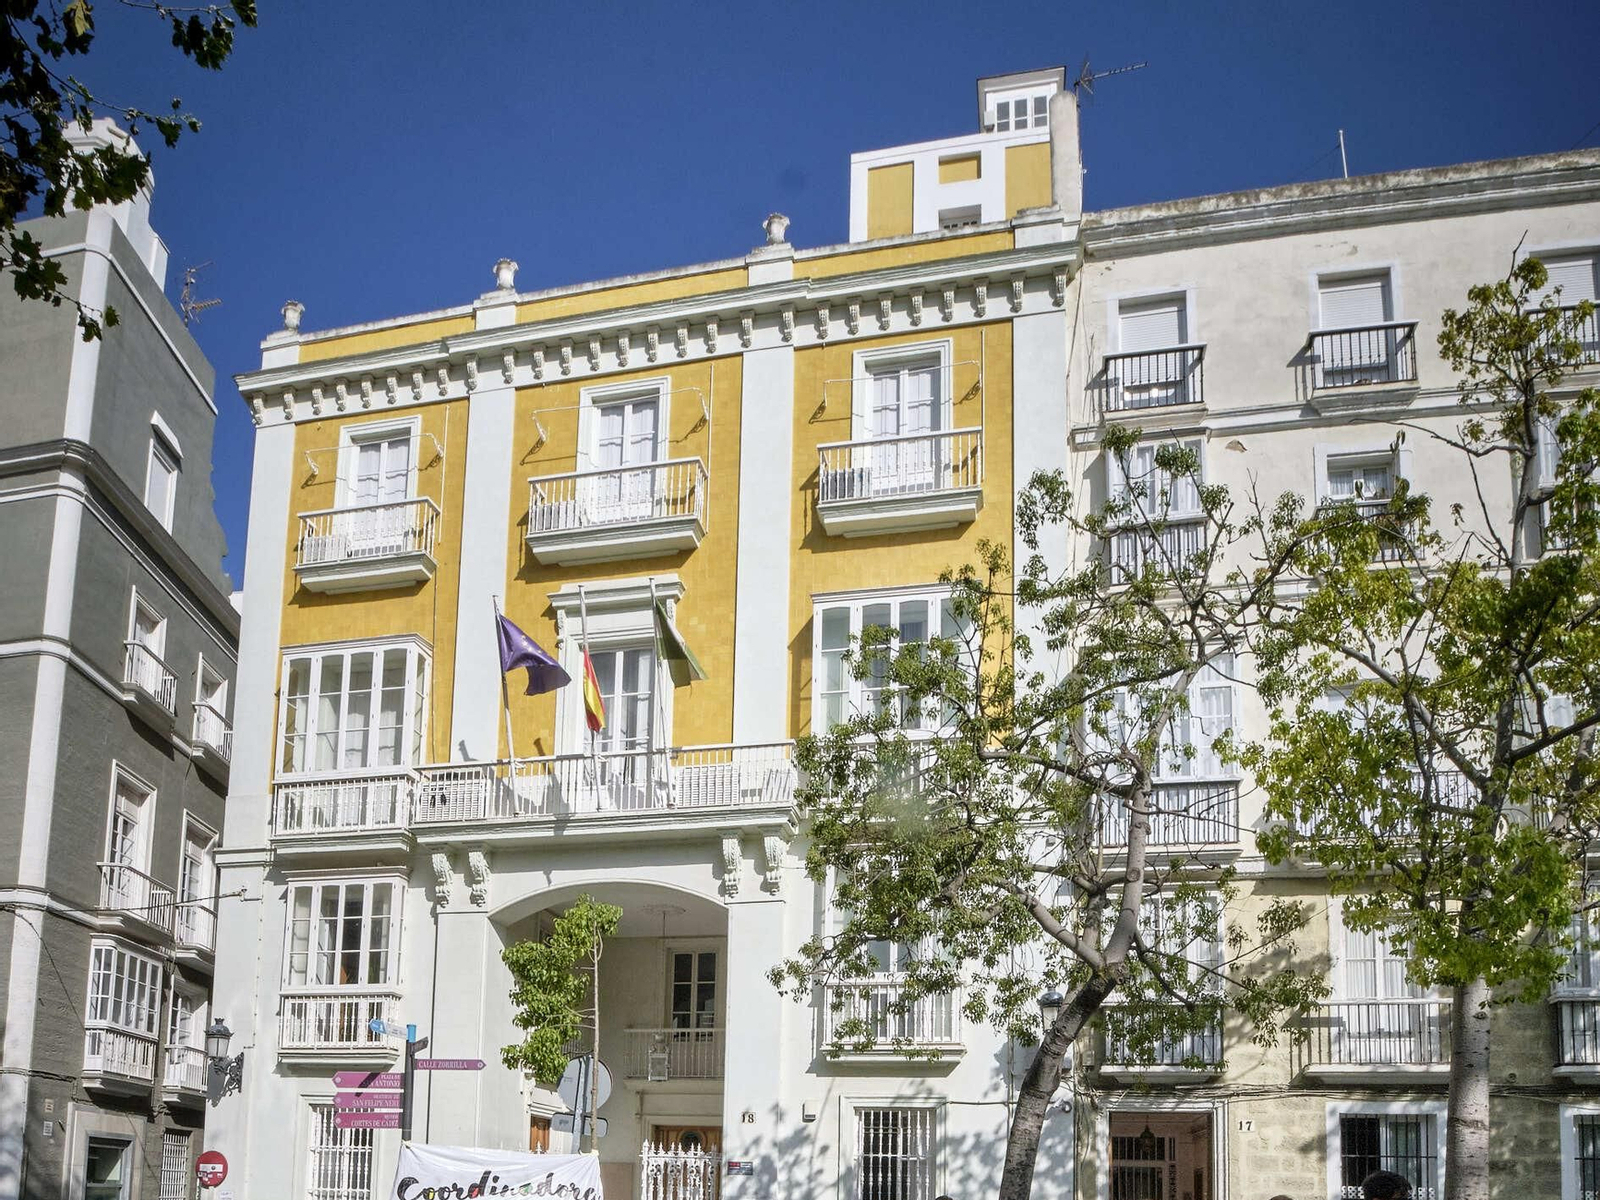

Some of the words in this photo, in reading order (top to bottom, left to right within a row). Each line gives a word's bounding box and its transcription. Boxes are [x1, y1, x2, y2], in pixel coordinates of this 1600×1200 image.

[418, 1061, 436, 1069] CALLE
[437, 1061, 468, 1069] ZORRILLA
[742, 1113, 754, 1123] 18
[1239, 1121, 1252, 1131] 17
